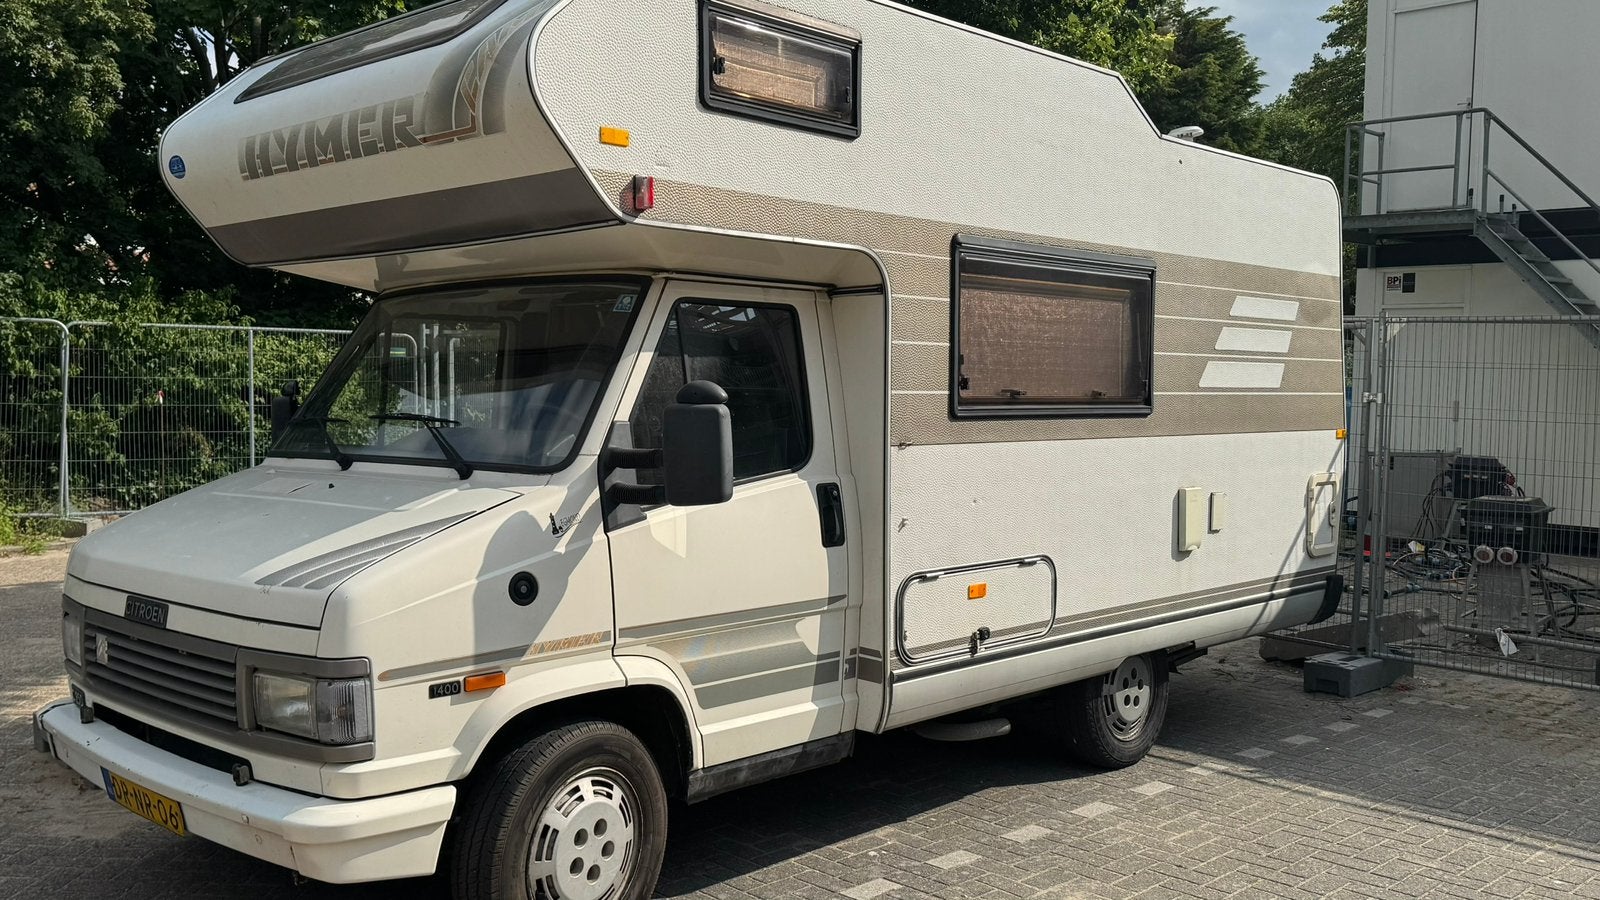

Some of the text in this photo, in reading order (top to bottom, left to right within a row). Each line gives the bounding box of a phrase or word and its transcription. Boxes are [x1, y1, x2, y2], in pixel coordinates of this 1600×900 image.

[240, 96, 424, 181] HYMER
[127, 600, 165, 624] CITROEN
[432, 682, 459, 697] 1400
[111, 775, 179, 830] DR-NR-06
